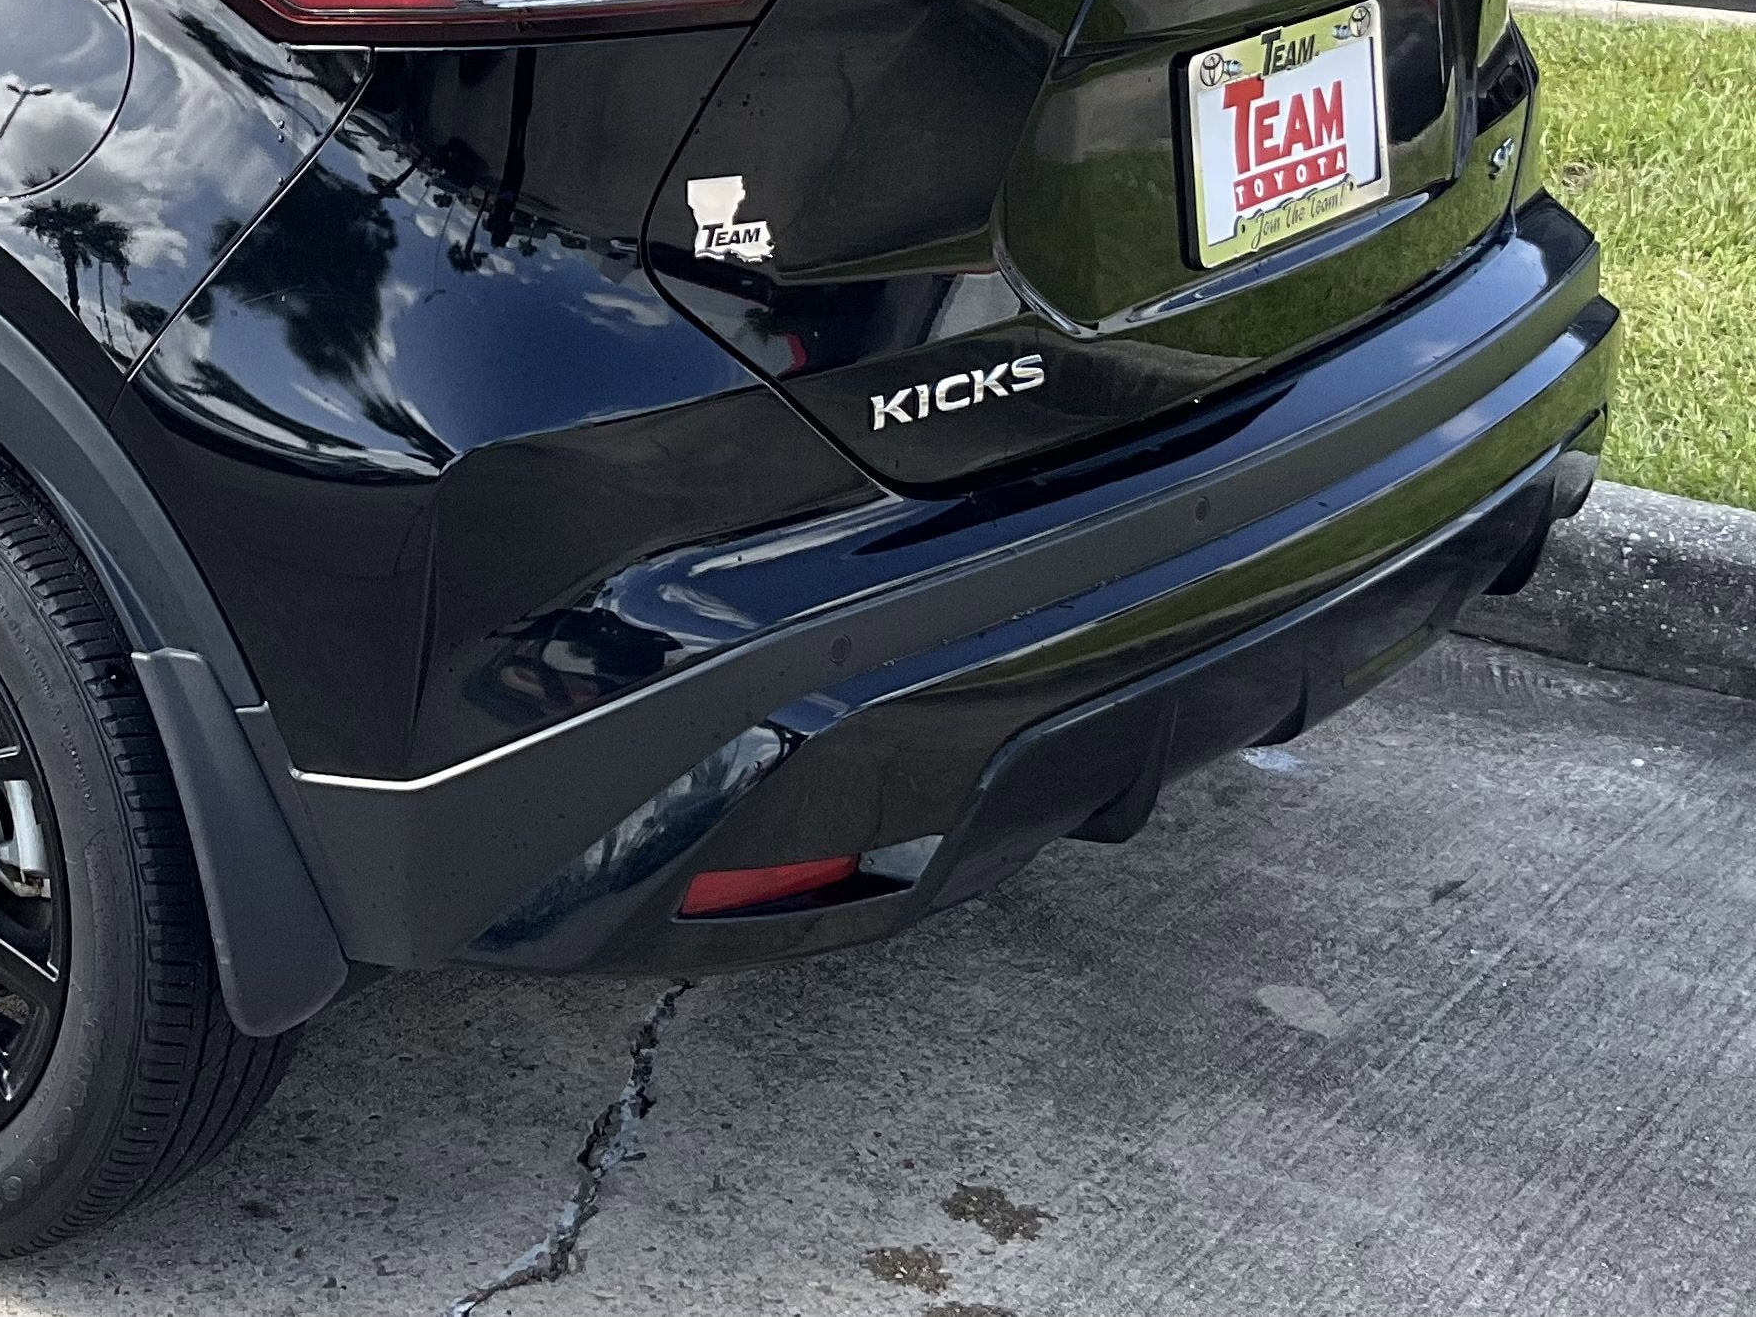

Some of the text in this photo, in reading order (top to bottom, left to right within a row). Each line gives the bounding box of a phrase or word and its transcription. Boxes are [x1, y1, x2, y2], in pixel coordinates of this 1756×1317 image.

[1261, 29, 1316, 77] TEAM
[1222, 77, 1345, 175] TEAM
[1235, 157, 1345, 206] TOYOTA
[701, 222, 762, 249] TEAM
[869, 352, 1047, 431] KICKS
